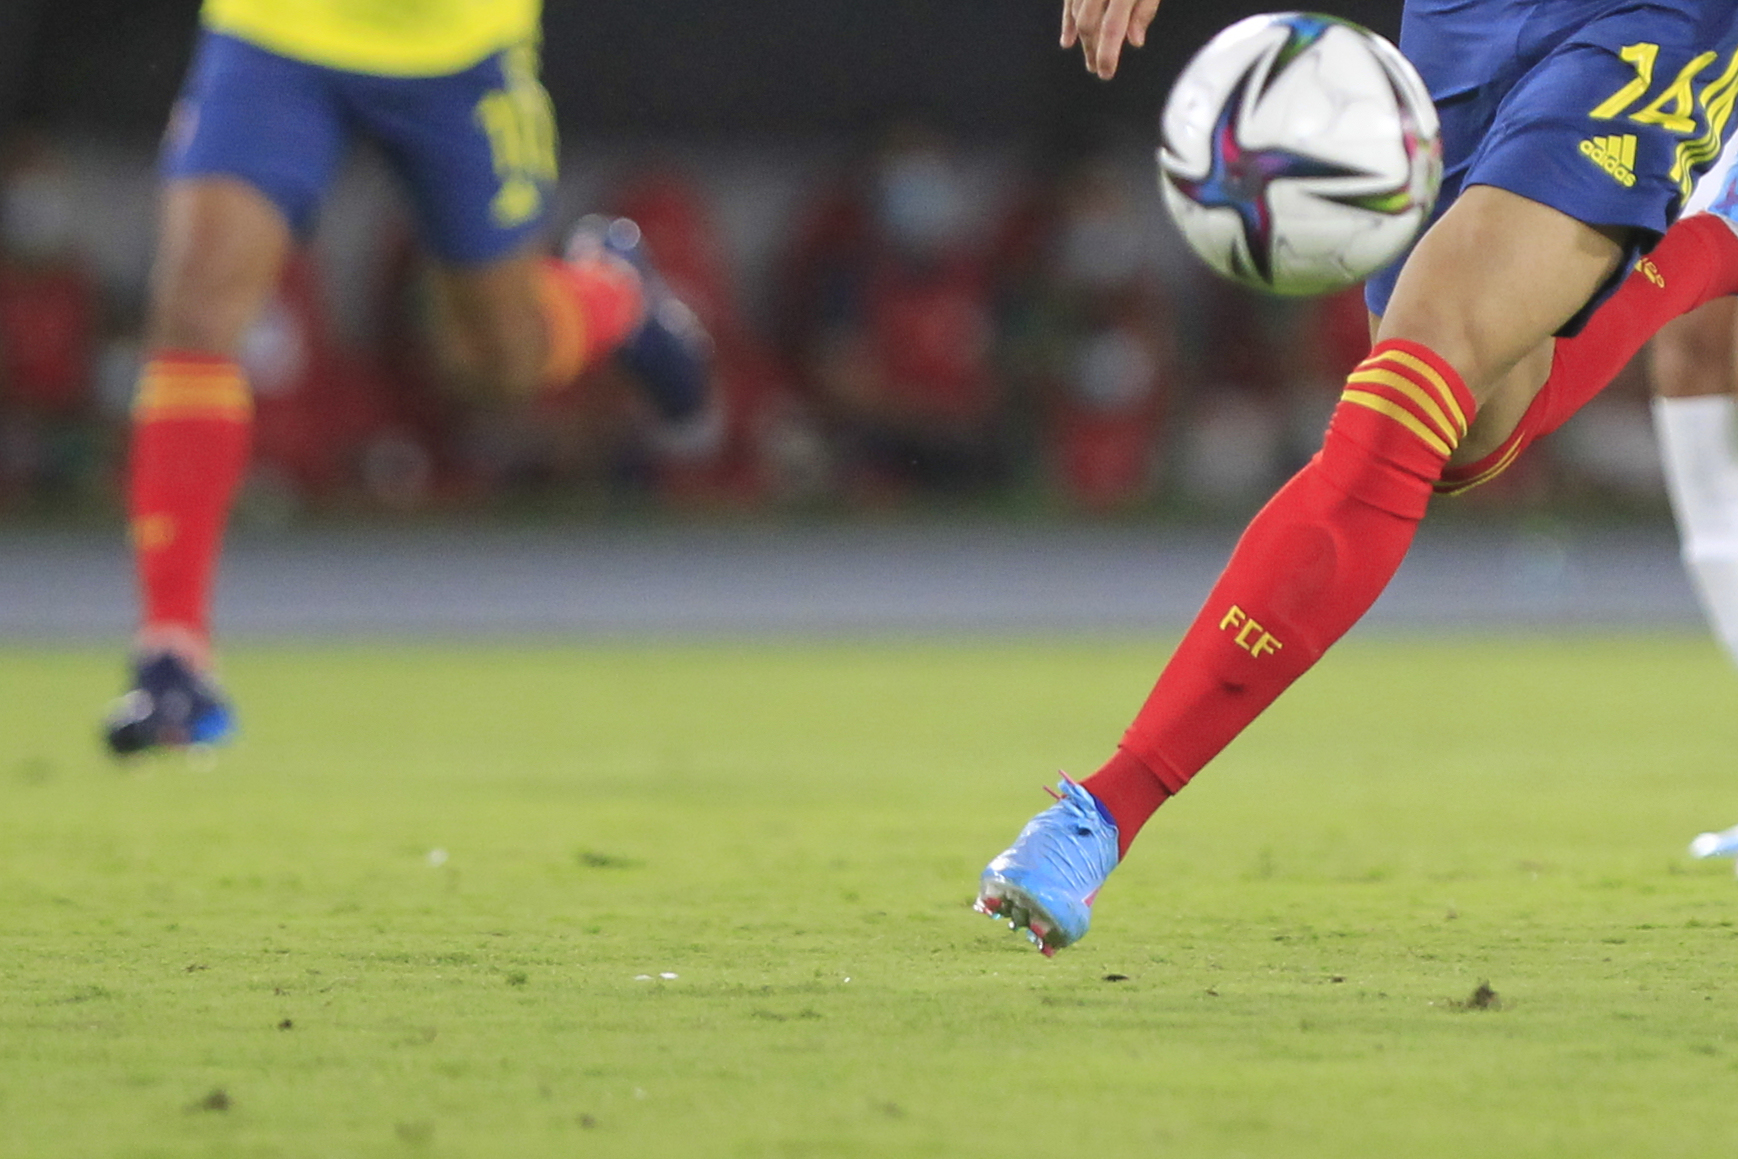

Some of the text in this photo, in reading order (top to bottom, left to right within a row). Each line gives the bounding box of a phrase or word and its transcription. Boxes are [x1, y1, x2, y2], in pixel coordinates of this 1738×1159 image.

[1589, 42, 1718, 132] 14
[1579, 139, 1637, 187] adidas
[1220, 604, 1283, 658] FCF
